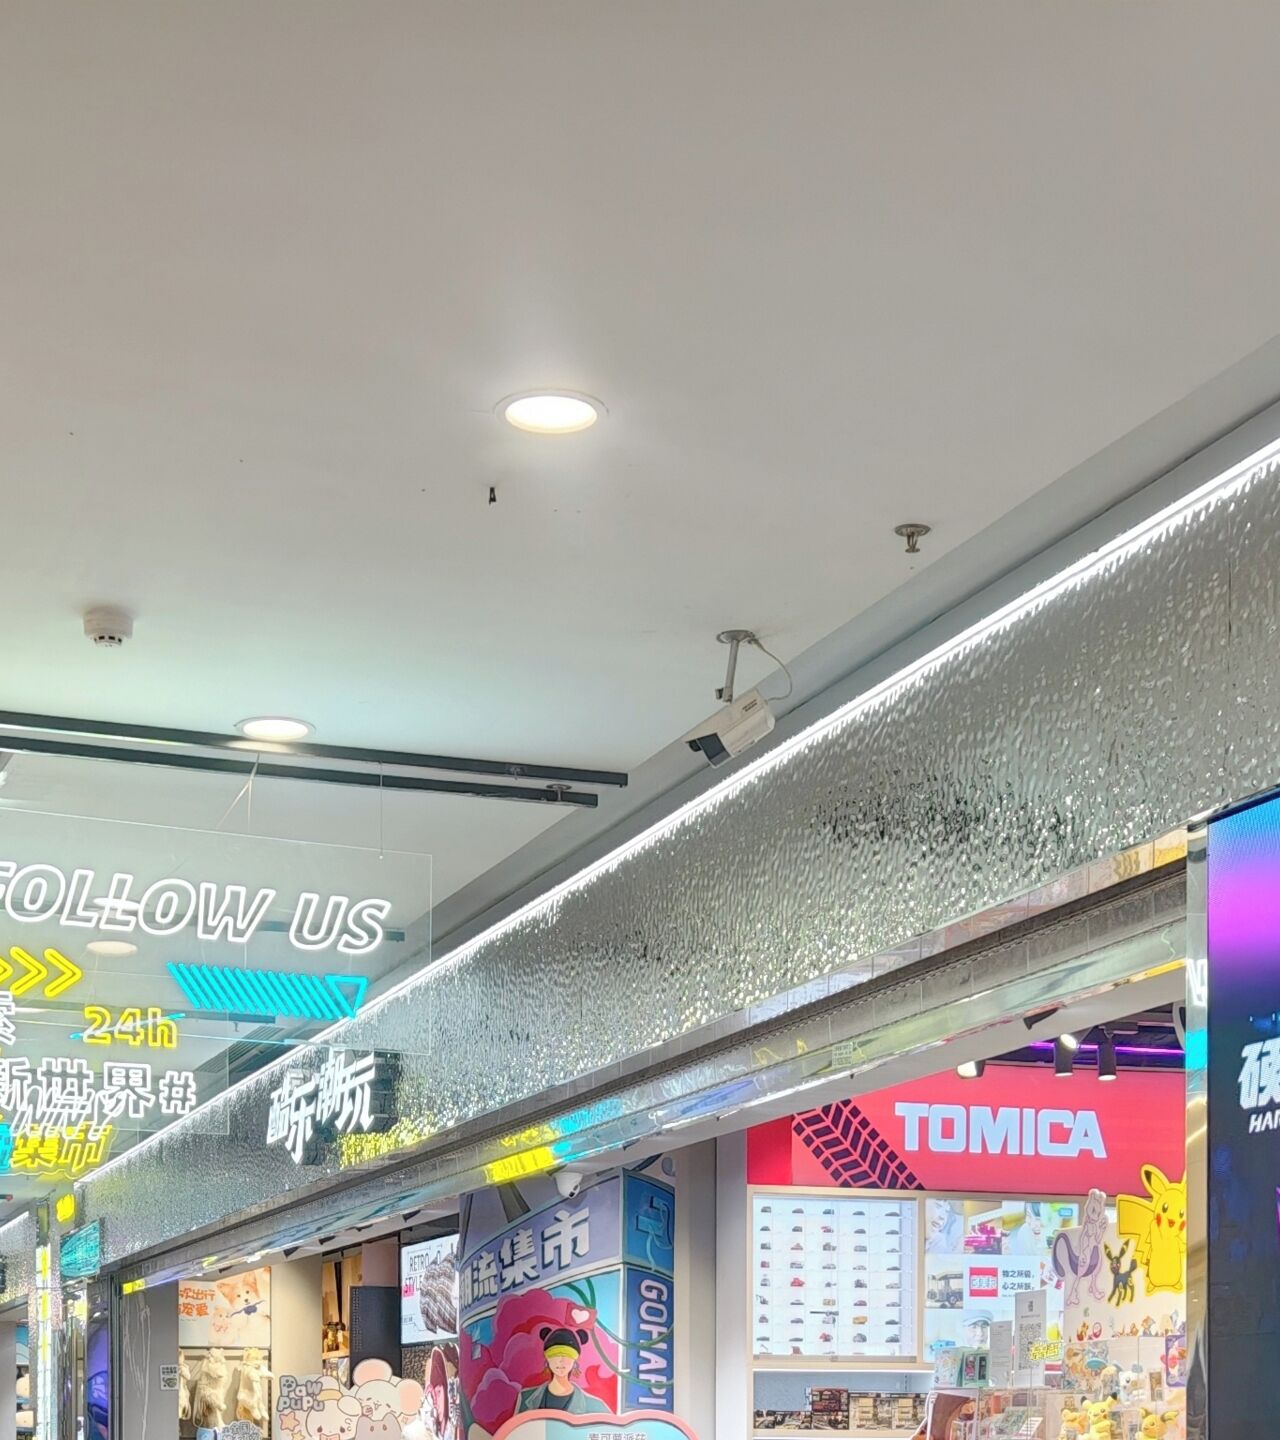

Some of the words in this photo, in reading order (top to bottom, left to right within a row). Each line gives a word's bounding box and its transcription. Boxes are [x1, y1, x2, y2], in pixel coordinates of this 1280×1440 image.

[288, 892, 391, 954] US
[83, 1005, 178, 1049] 24h
[894, 1102, 1108, 1158] TOMICA
[638, 1279, 668, 1406] GOHAPI
